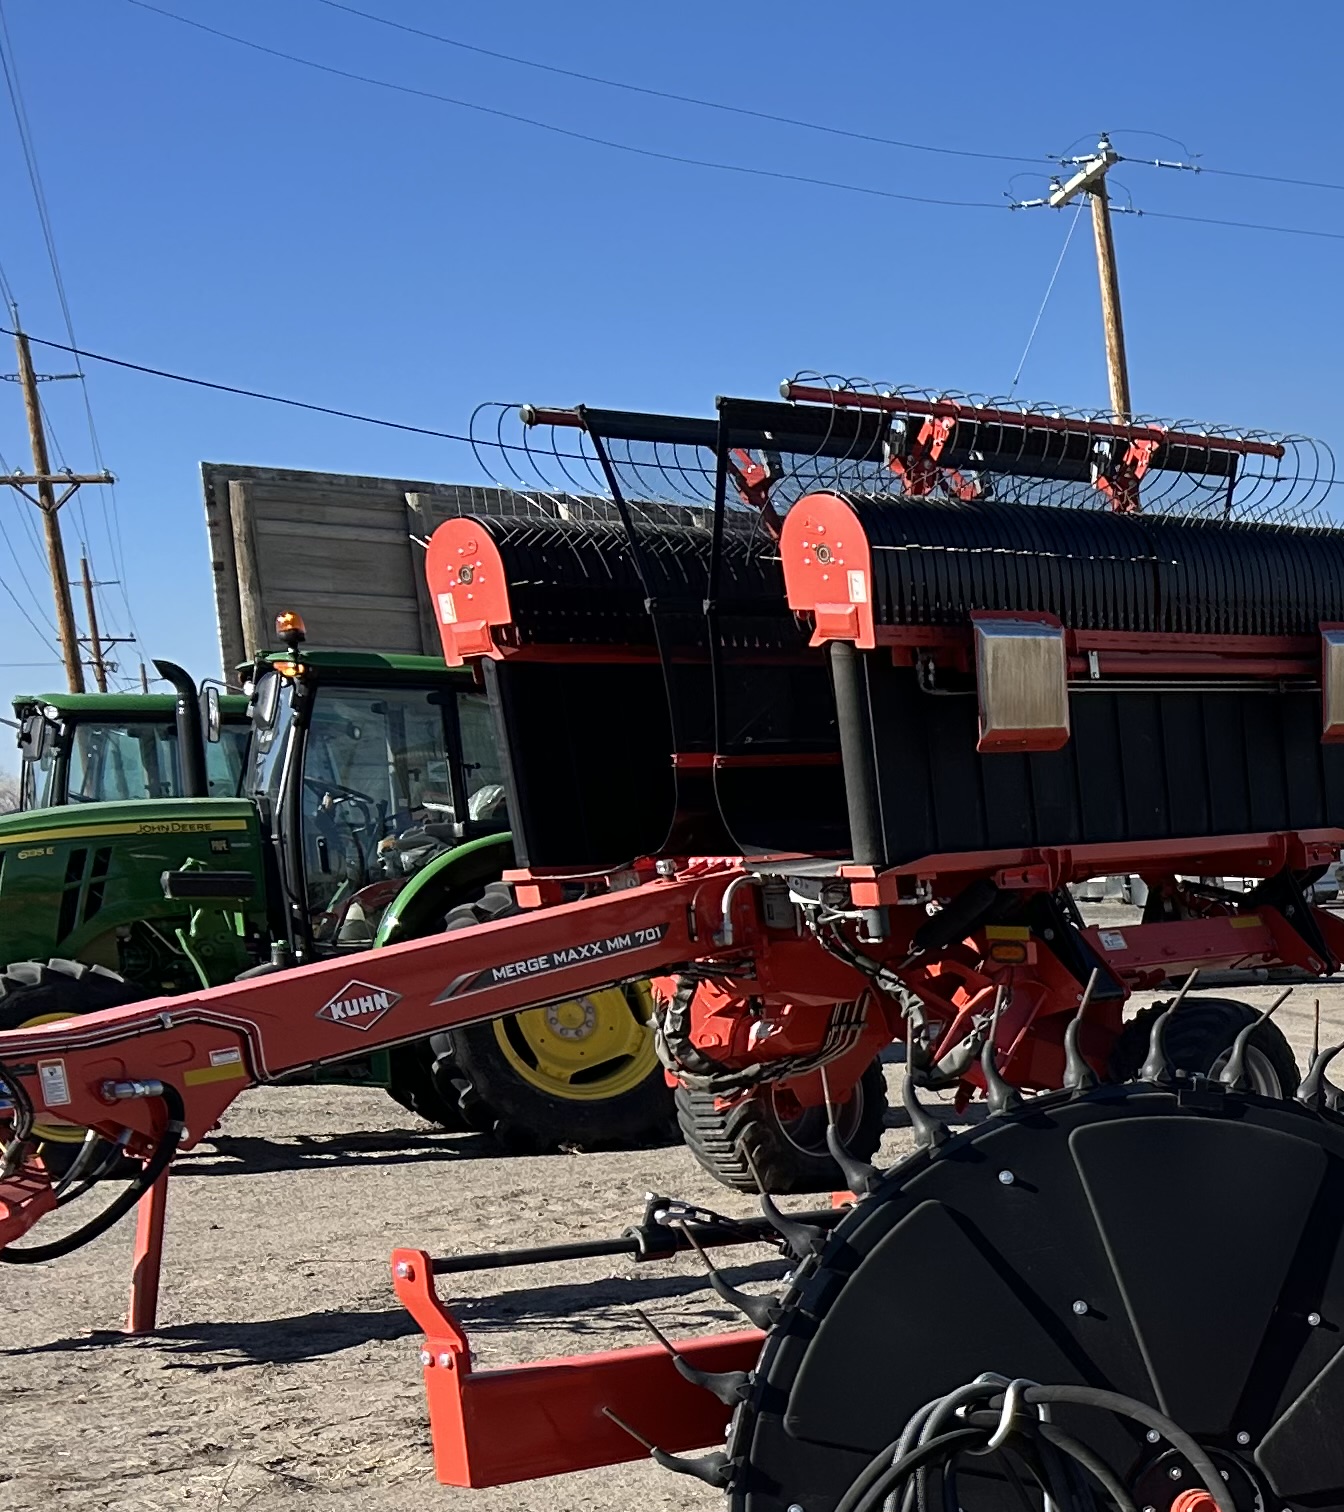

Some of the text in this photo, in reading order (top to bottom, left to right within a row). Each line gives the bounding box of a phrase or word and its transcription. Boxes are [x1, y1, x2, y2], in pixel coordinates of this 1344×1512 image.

[136, 822, 212, 835] JOHN DEERE
[491, 926, 662, 981] MERGE MAXX MM 701
[330, 992, 389, 1020] KUHN
